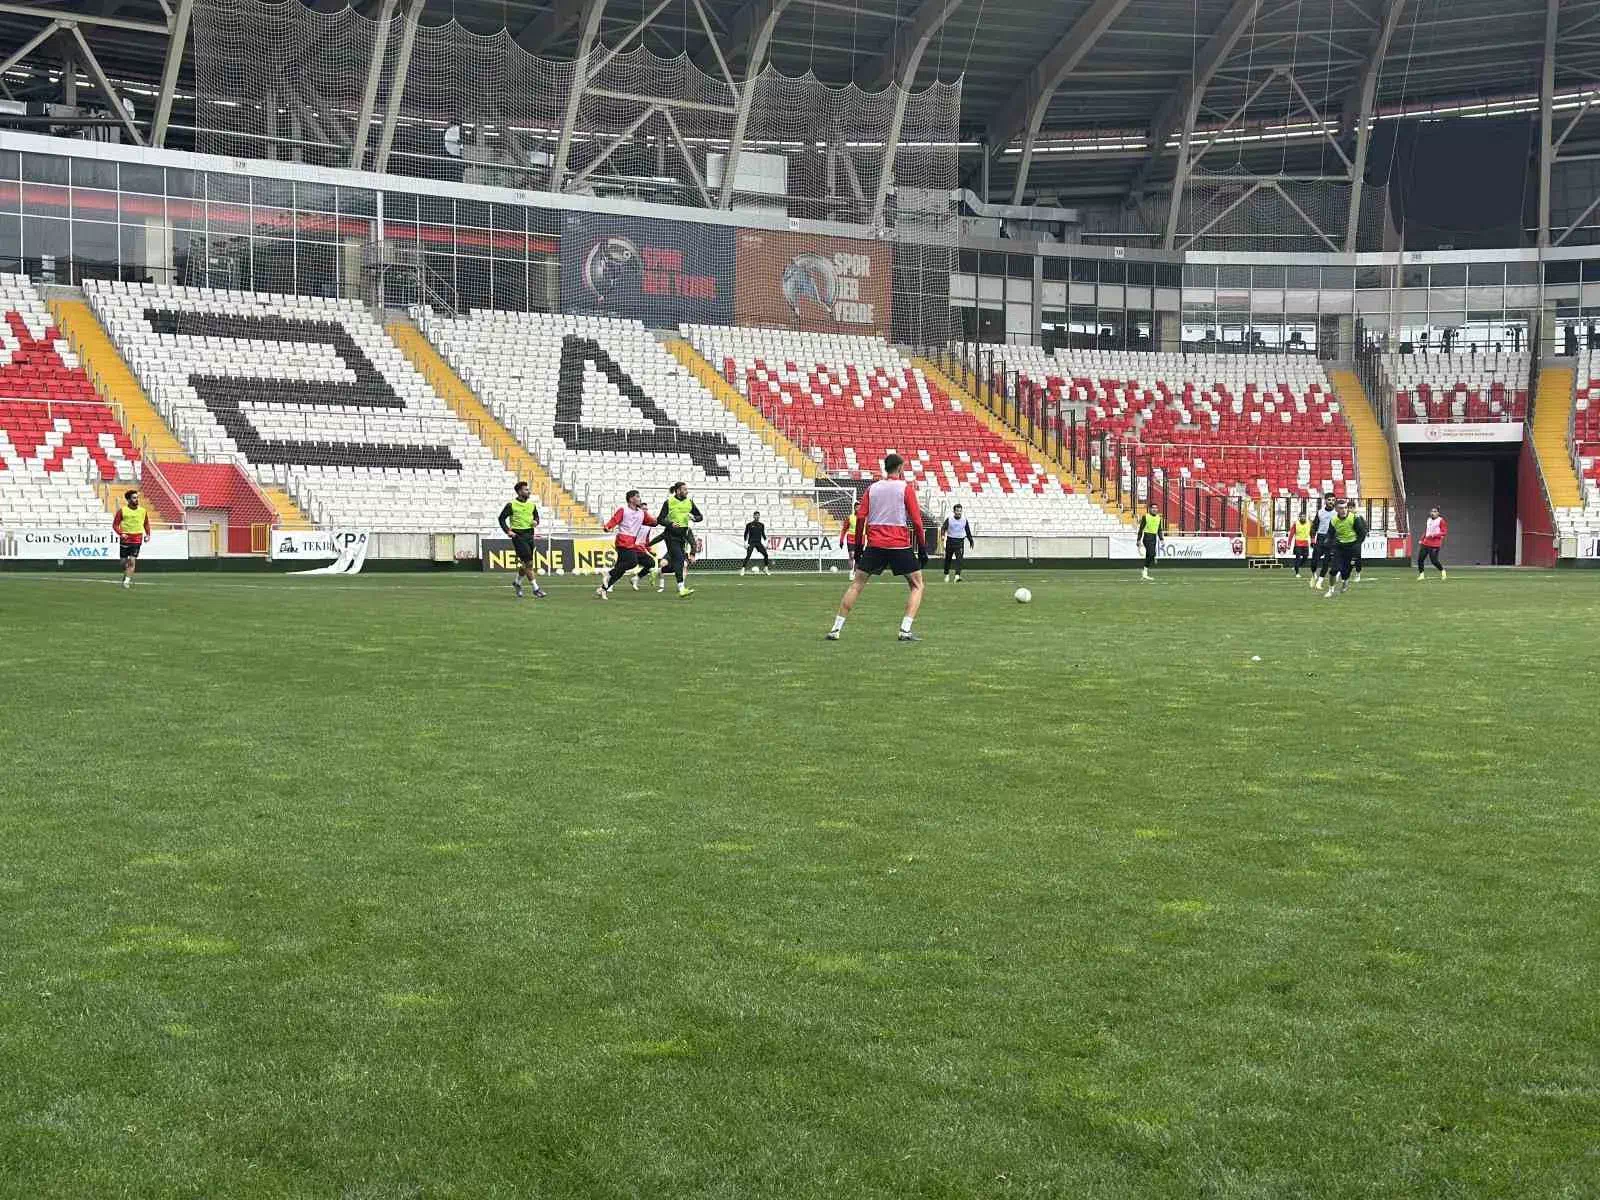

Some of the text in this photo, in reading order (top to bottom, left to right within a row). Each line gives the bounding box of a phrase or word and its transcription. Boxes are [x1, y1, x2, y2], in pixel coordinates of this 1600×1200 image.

[834, 252, 870, 277] SPOR
[25, 533, 50, 543] Can
[53, 533, 106, 545] Soylular
[782, 536, 832, 551] AKPA
[67, 547, 109, 557] AYGAZ
